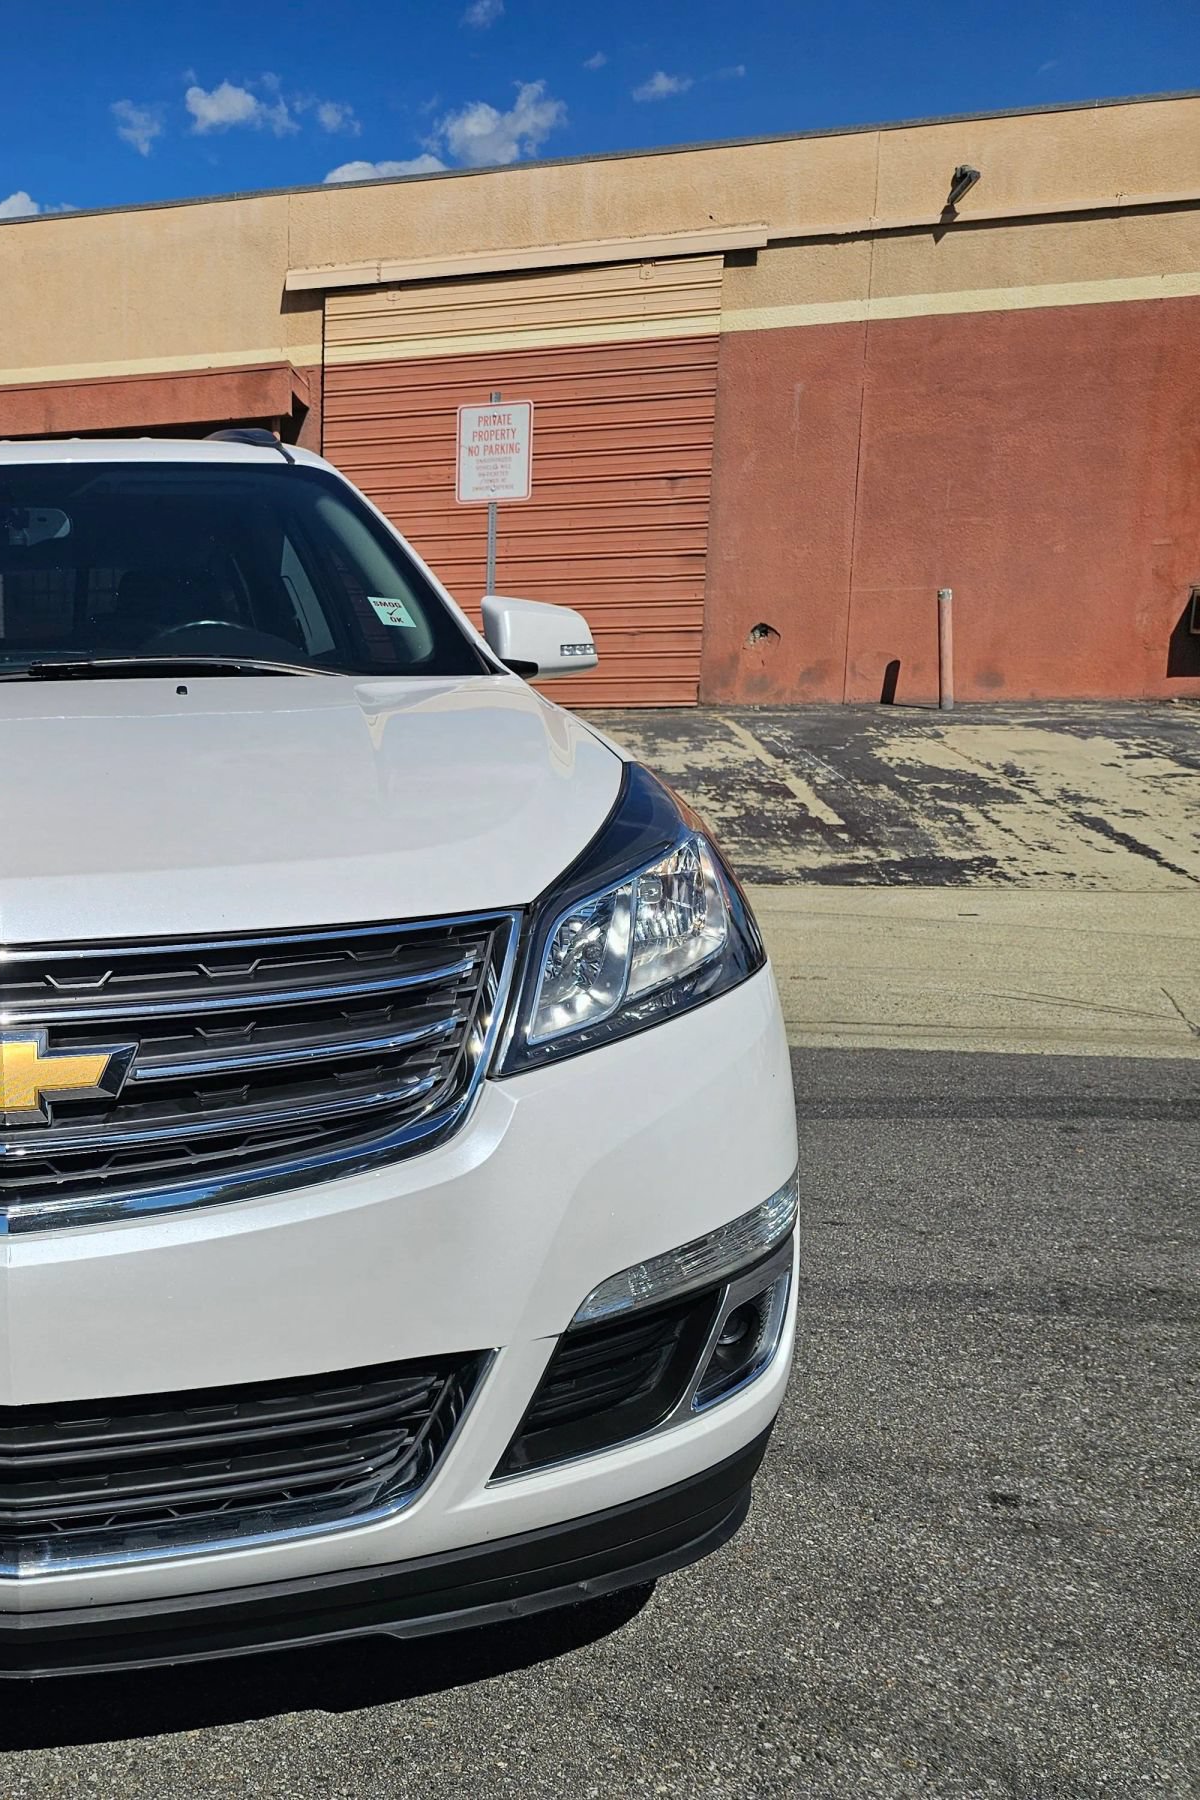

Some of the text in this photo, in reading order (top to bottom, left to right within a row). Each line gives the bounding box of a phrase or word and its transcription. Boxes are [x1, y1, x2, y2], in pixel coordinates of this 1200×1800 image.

[478, 414, 512, 427] PRIVATE
[472, 429, 517, 442] PROPERTY
[468, 442, 521, 457] NO PARKING
